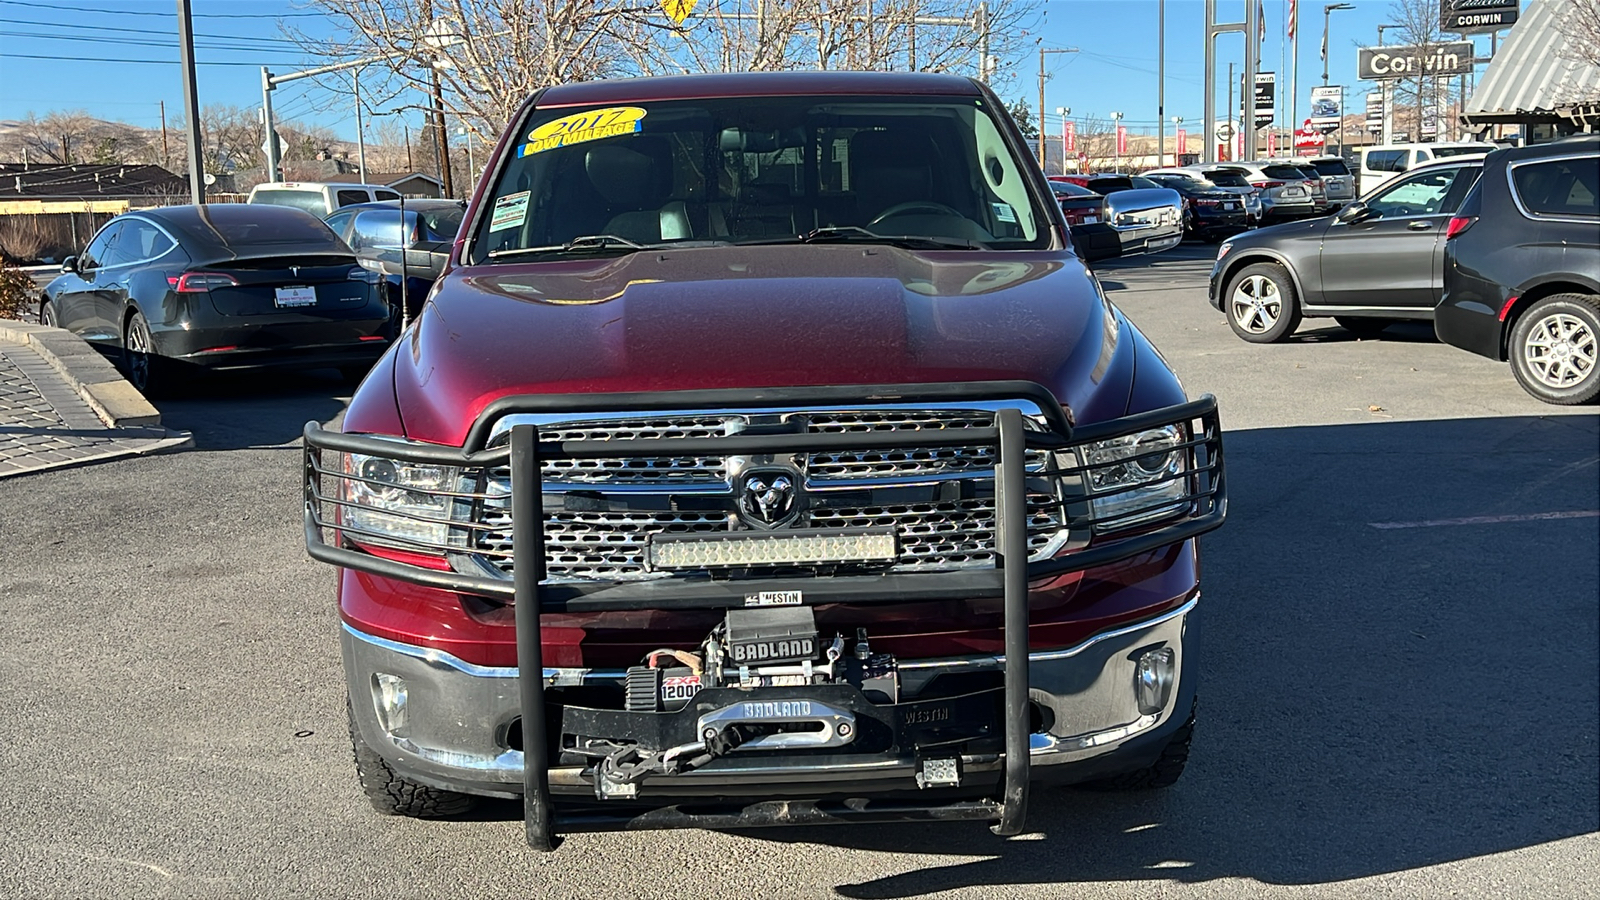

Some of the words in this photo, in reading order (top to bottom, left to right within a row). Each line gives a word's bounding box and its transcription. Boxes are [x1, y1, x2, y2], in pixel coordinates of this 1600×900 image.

[1457, 14, 1502, 25] CORWIN
[1370, 48, 1458, 74] Corwin
[549, 110, 627, 137] 2017
[524, 136, 562, 156] LOW
[562, 121, 636, 146] MILEAGE
[734, 639, 813, 661] BADLAND
[664, 676, 700, 685] ZXR
[744, 701, 811, 717] BADLAND
